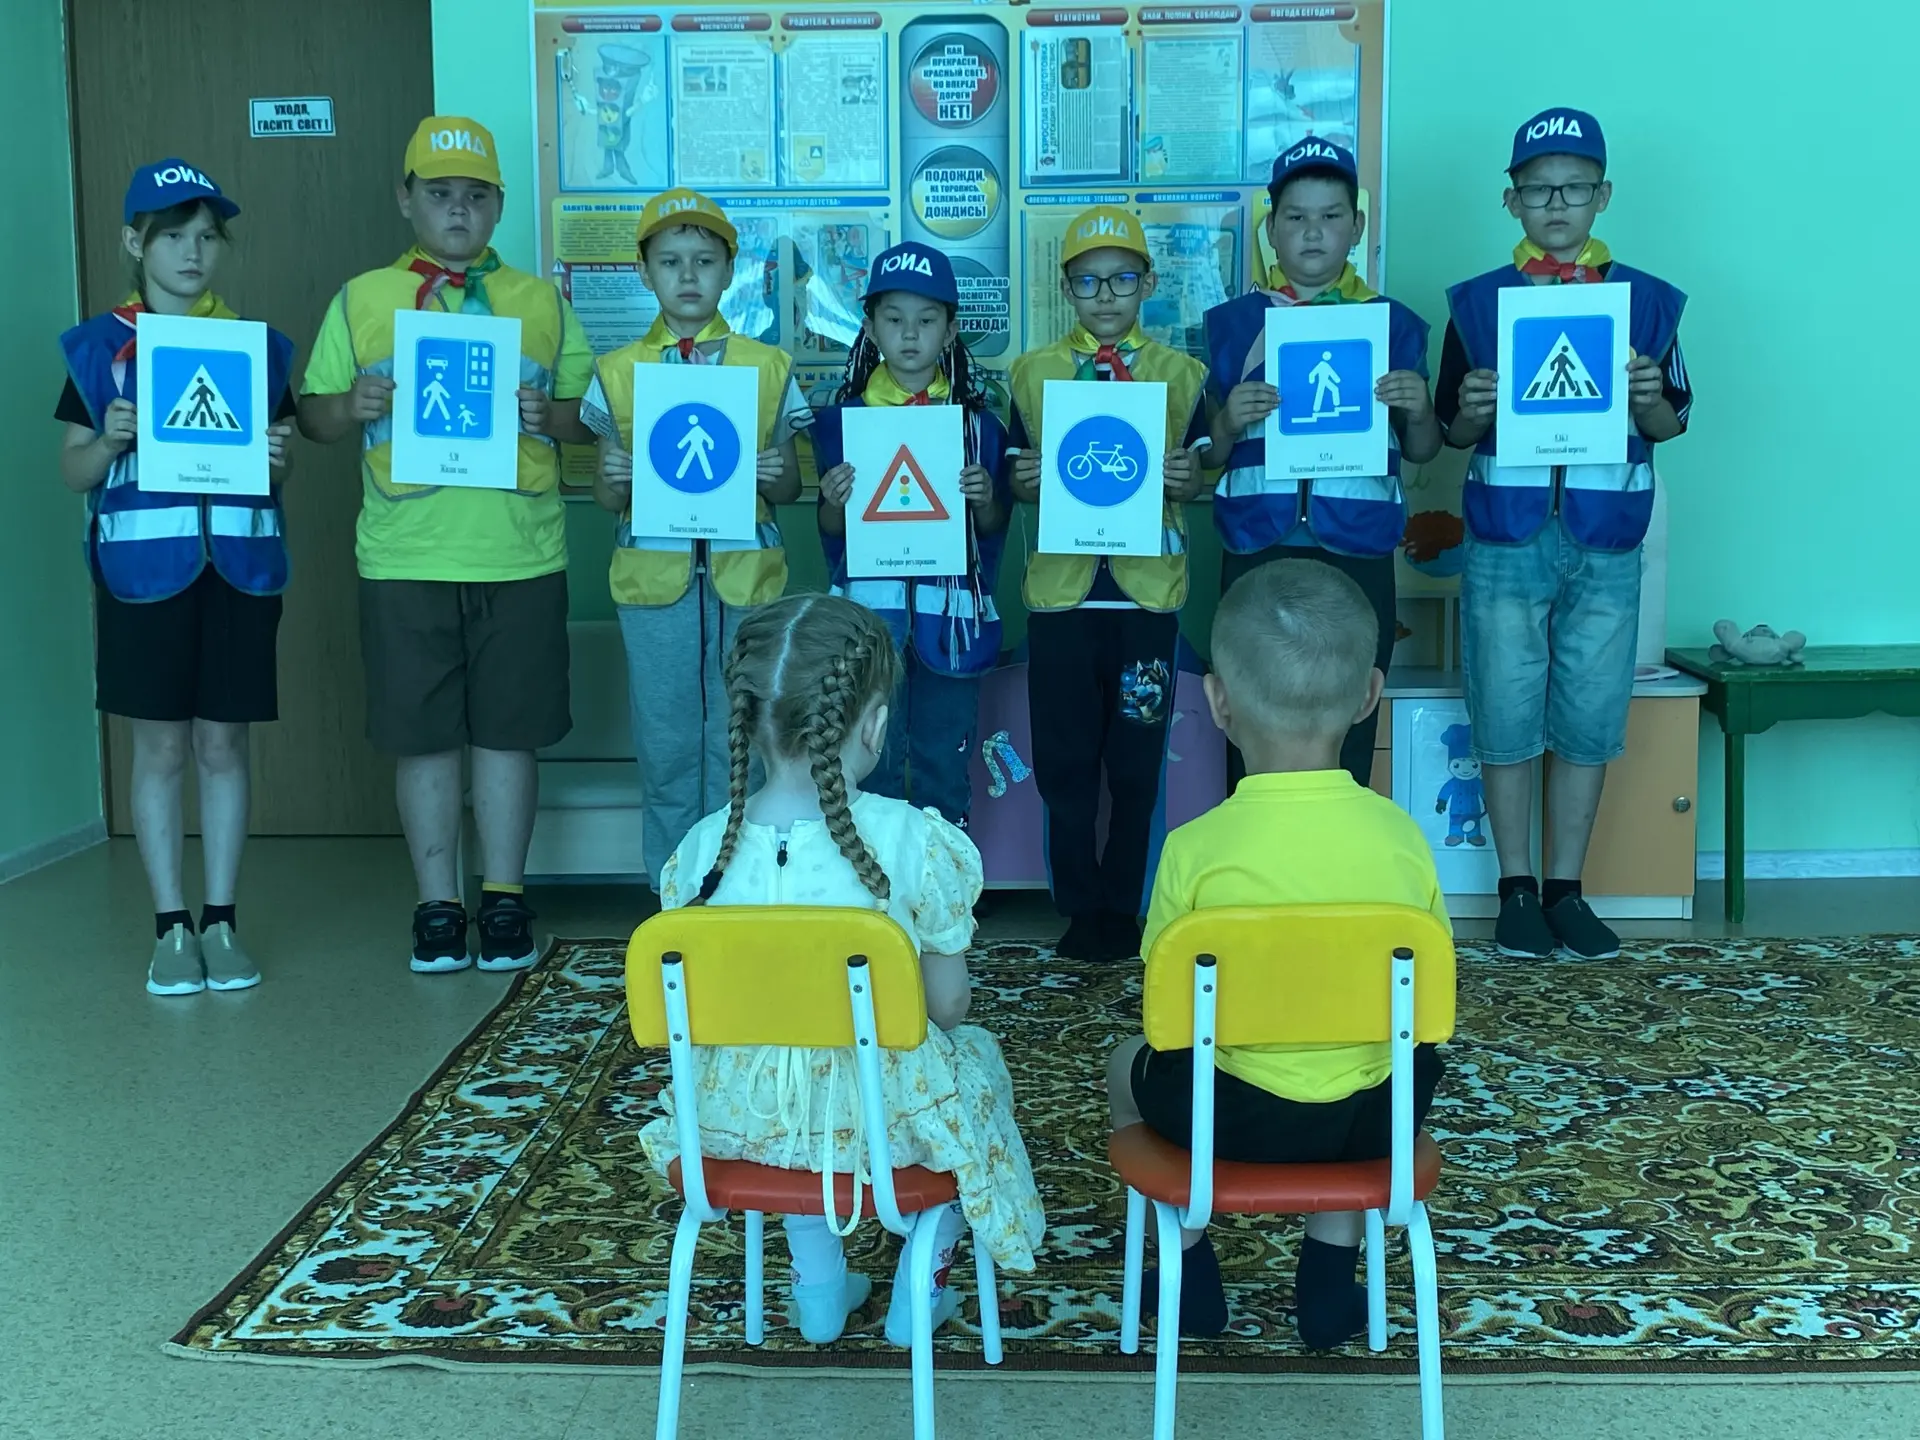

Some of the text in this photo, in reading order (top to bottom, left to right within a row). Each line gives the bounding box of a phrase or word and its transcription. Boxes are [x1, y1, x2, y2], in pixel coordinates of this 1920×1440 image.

[932, 58, 977, 67] ПРЕКРАСЕН
[923, 67, 963, 77] КРАСНЫЙ
[933, 80, 976, 89] НО ВПЕРЕД
[939, 91, 971, 100] ДОРОГИ
[939, 104, 971, 119] НЕТ!
[257, 119, 294, 131] ГАСИТЕ
[1526, 116, 1583, 143] ЮИД
[430, 129, 488, 158] ЮИД
[1285, 143, 1339, 167] ЮИД
[153, 165, 215, 191] ЮИД
[925, 169, 987, 183] ПОДОЖДИ,
[930, 185, 939, 193] НЕ
[967, 194, 986, 203] СВЕТ
[925, 205, 986, 219] ДОЖДИСЬ!
[881, 252, 933, 277] ЮИД
[958, 279, 1009, 288] ЕВО, ВПРАВО
[959, 304, 1007, 312] ИМАТЕЛЬНО
[960, 319, 1008, 332] РЕХОДИ
